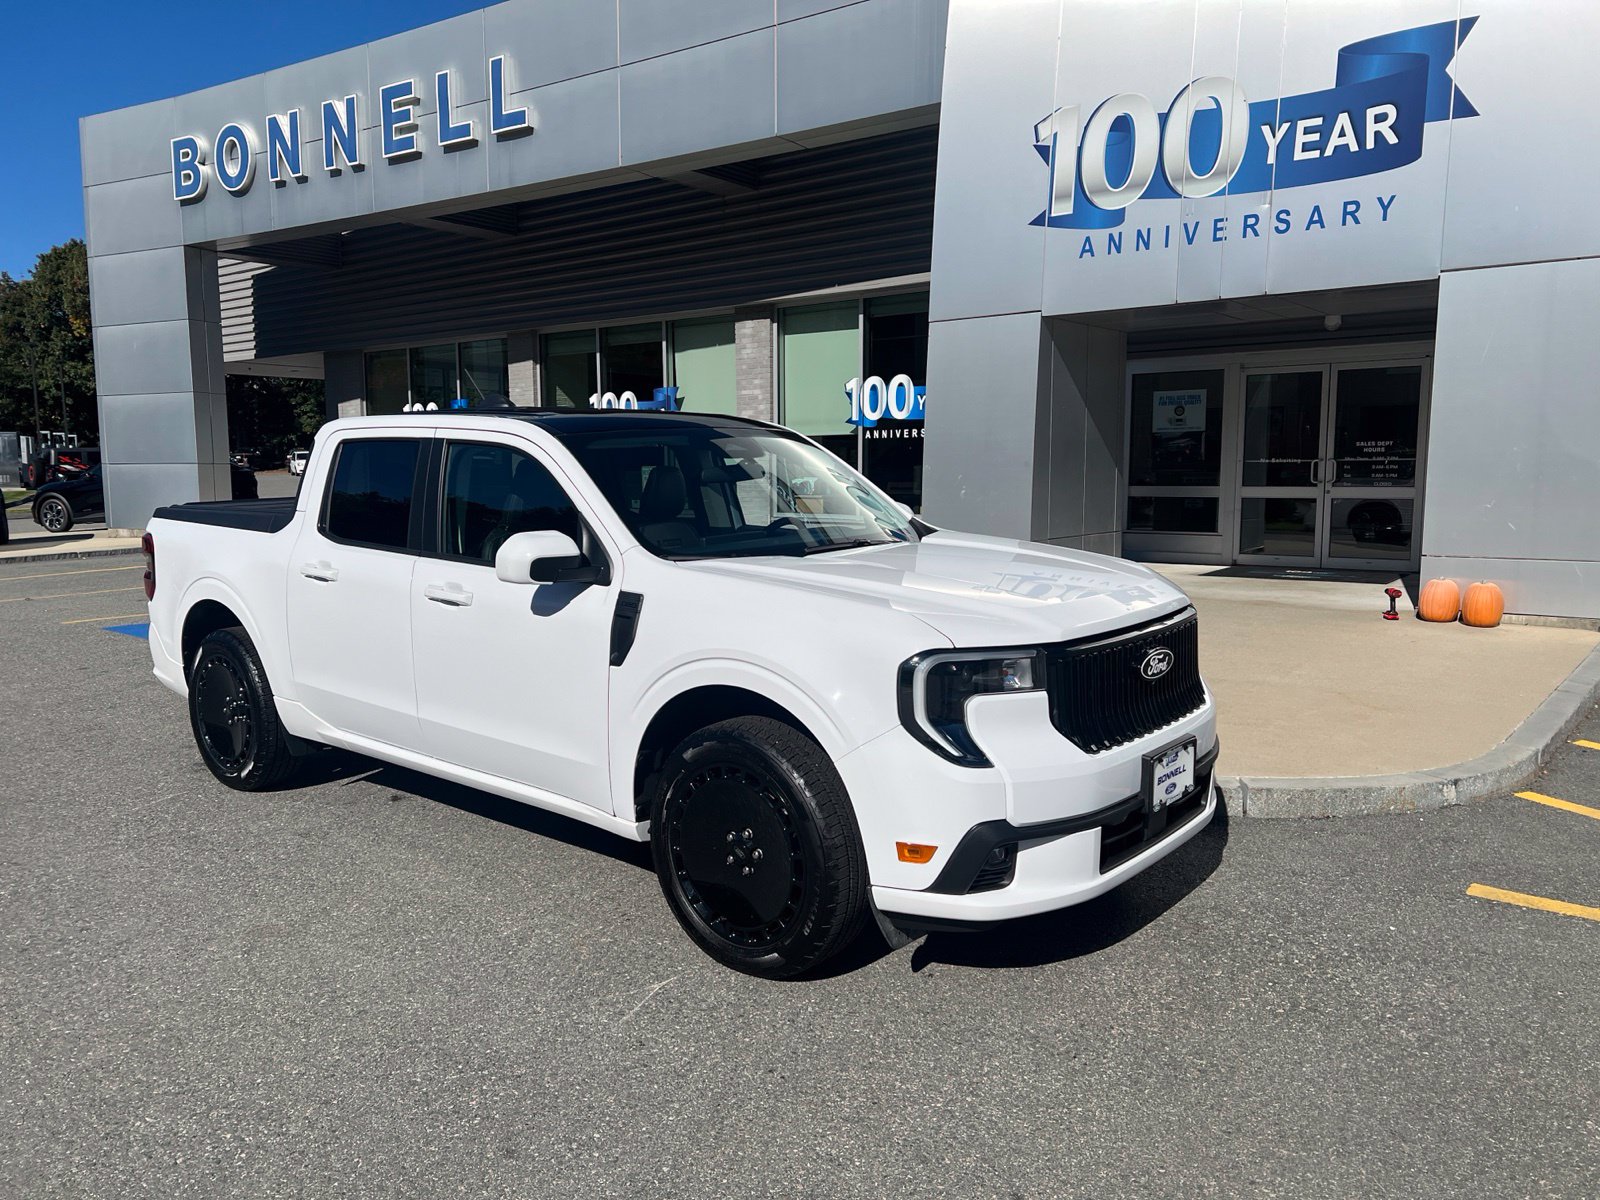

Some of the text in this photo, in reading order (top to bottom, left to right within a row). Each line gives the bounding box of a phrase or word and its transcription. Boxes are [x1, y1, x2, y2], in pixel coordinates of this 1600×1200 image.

[171, 54, 530, 203] BONNELL
[1034, 76, 1400, 217] 100 YEAR
[1079, 194, 1397, 259] ANNIVERSARY
[844, 373, 915, 421] 100
[1147, 653, 1169, 676] Ford
[1158, 765, 1186, 785] BONNELL
